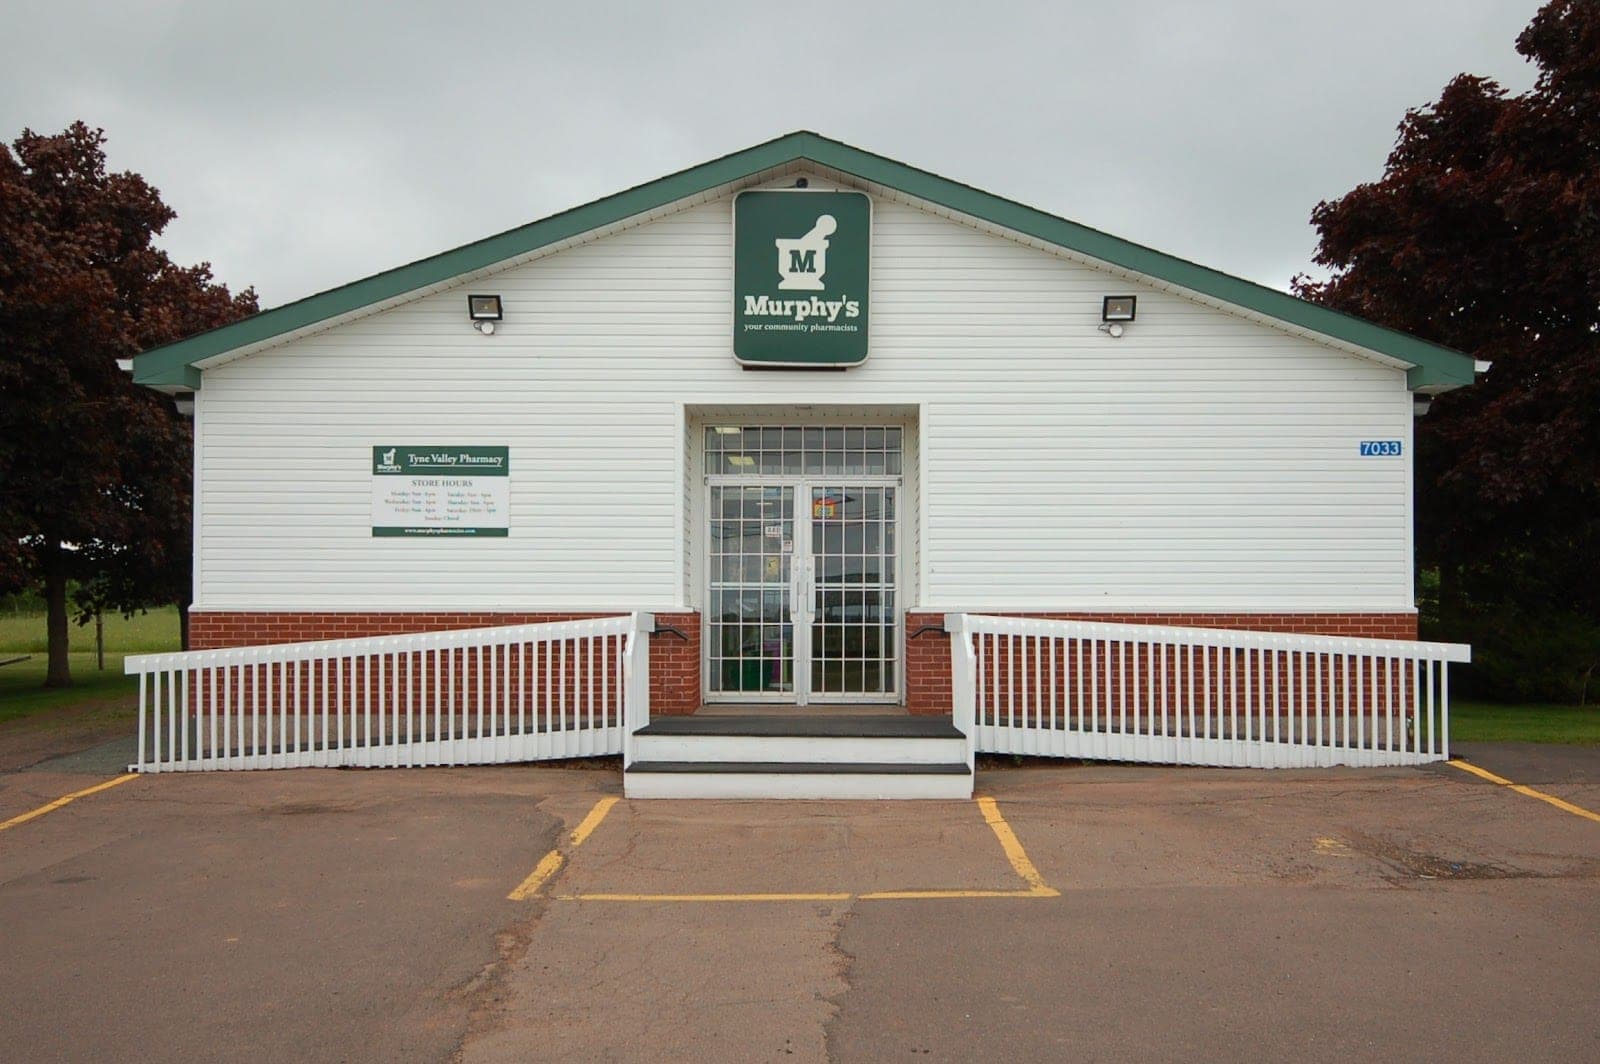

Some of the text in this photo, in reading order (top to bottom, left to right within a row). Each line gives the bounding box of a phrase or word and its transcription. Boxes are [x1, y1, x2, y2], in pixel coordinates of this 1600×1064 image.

[789, 250, 816, 273] M
[743, 294, 860, 322] Murphy's
[744, 323, 858, 332] your community pharmacists
[1362, 442, 1399, 455] 7033
[408, 454, 503, 466] Tyne Valley Pharmacy
